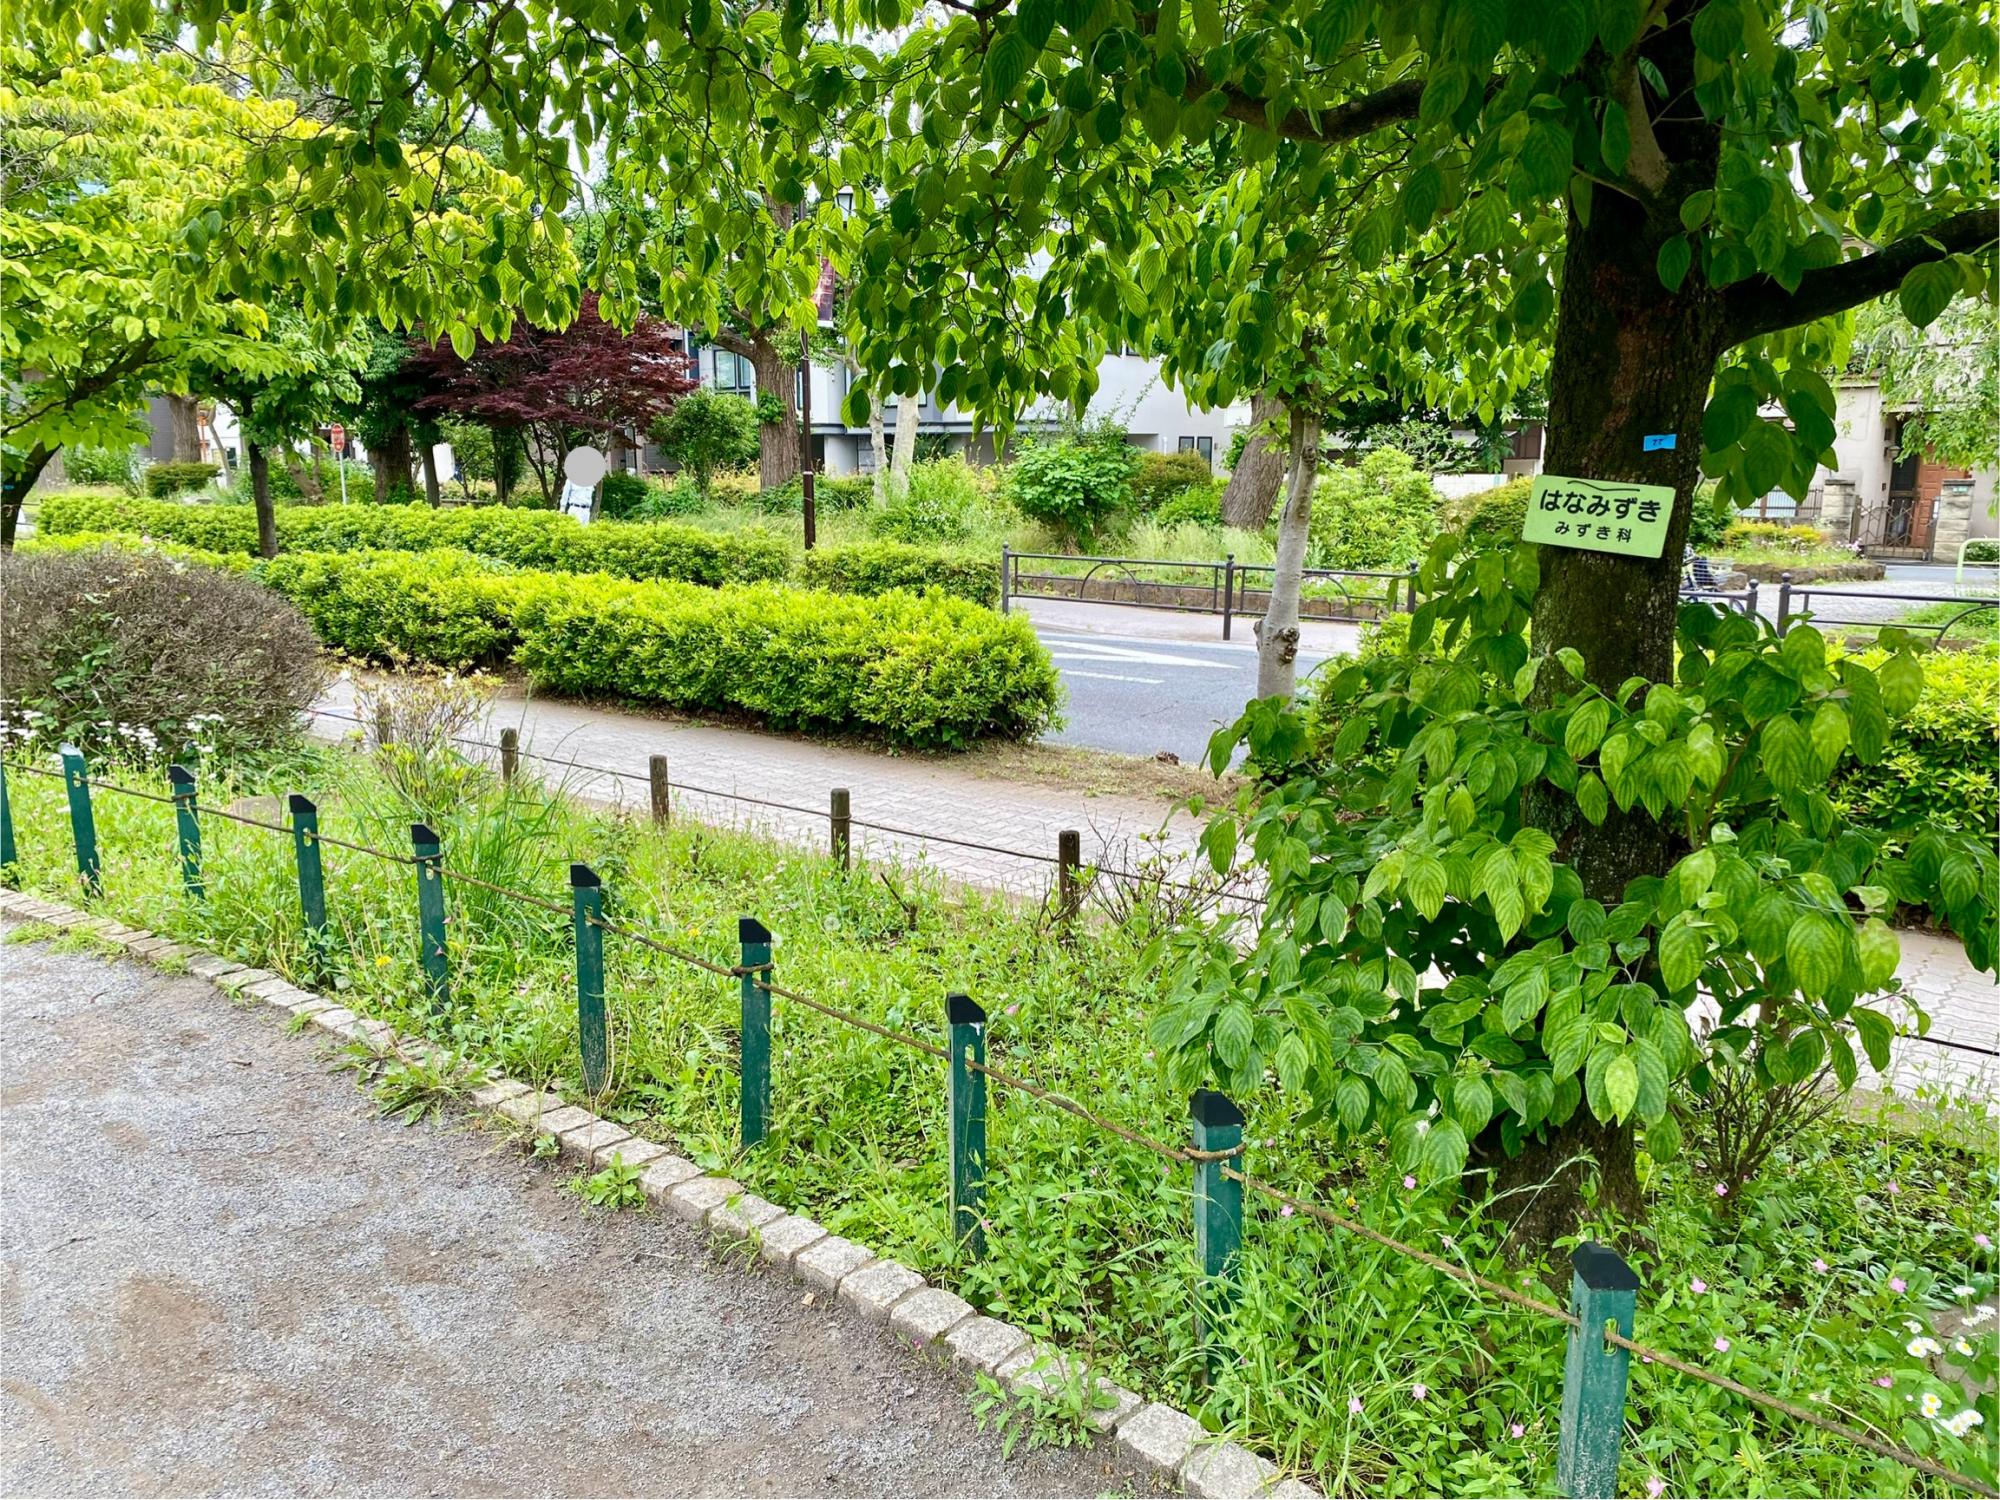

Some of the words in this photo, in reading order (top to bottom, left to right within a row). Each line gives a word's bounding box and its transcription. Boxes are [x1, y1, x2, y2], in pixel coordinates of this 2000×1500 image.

[1540, 489, 1661, 522] はなみずき
[1555, 521, 1632, 543] みずき科
